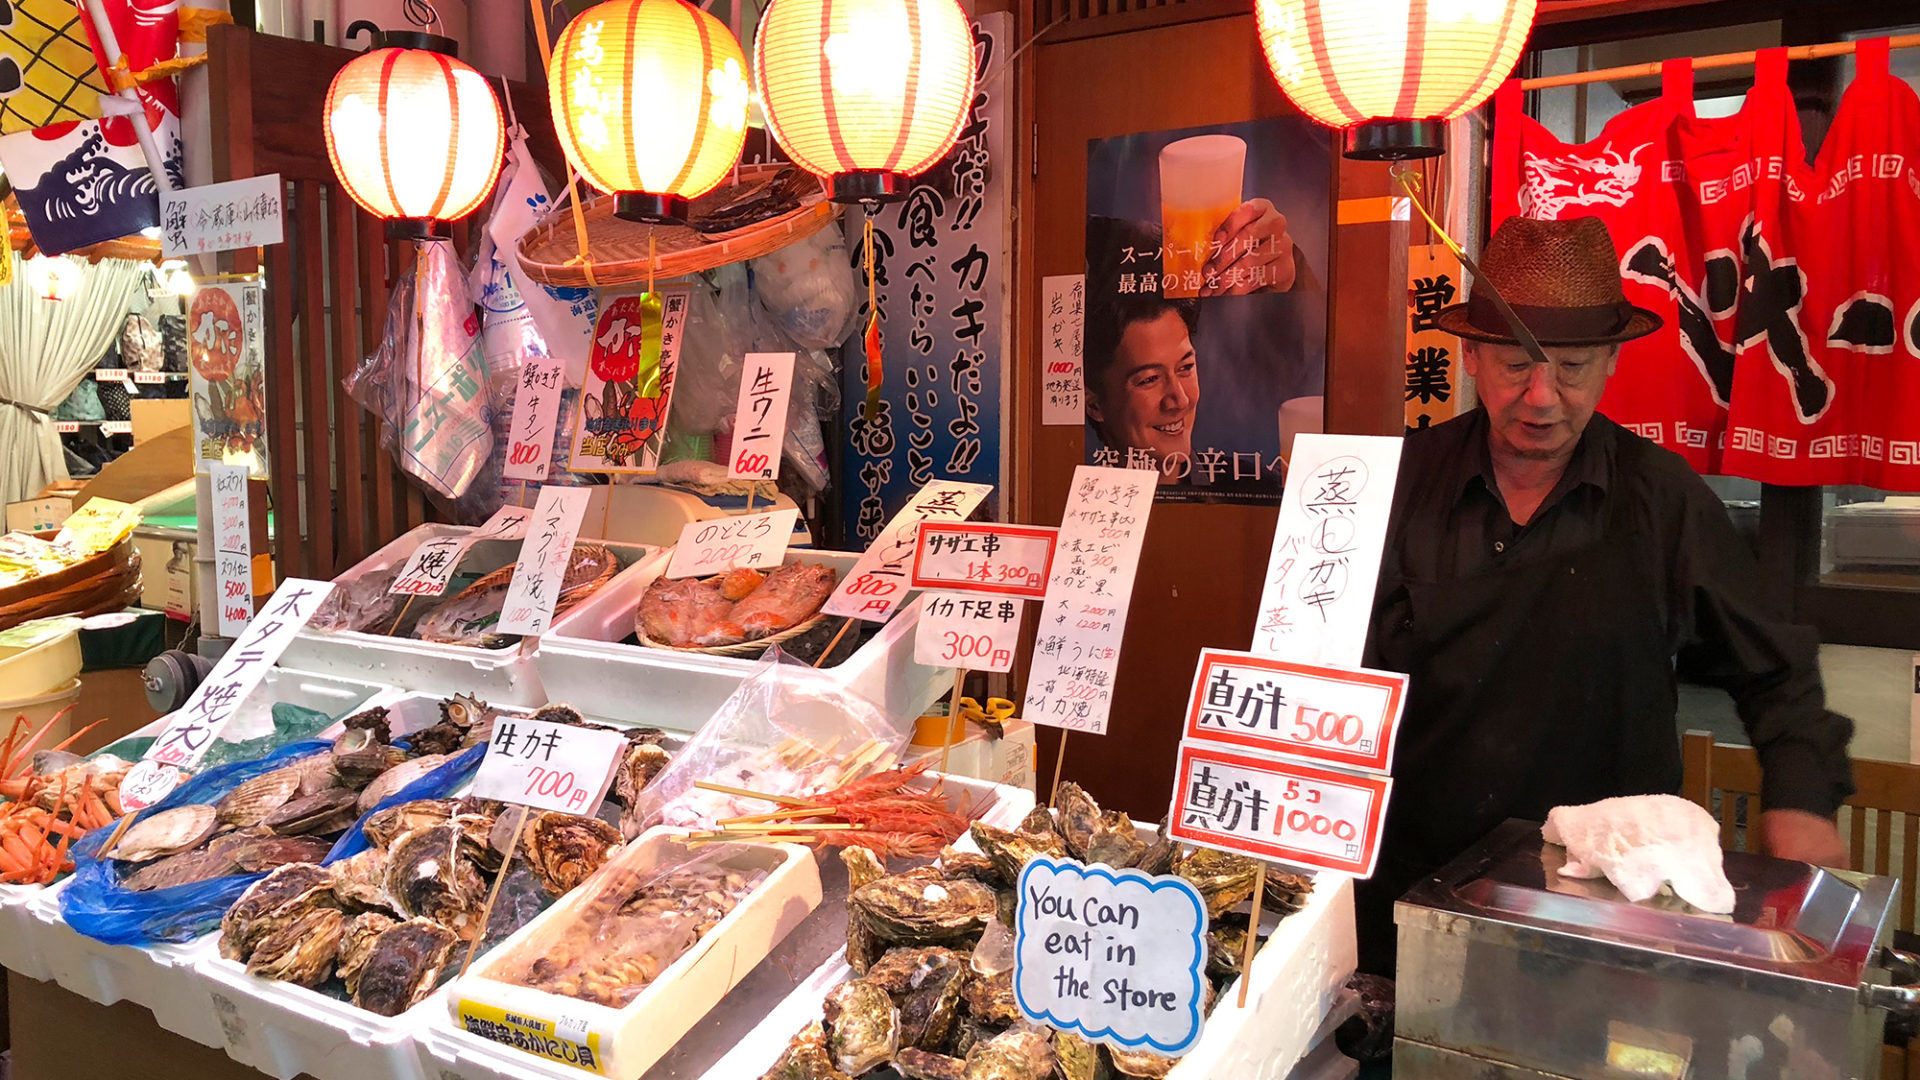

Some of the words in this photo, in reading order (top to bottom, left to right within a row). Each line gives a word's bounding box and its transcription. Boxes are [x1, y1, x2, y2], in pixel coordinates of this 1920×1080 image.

[1119, 233, 1283, 265] スーパードライ史上
[1117, 264, 1278, 294] 最高の泡を実現!
[524, 394, 545, 442] 牛タン
[743, 366, 780, 442] 生ウニ
[695, 516, 772, 544] のどくろ
[927, 533, 1001, 558] サザエ串
[1303, 466, 1358, 623] 蒸しガキ
[998, 566, 1042, 587] 300円
[1260, 535, 1306, 651] バター蒸し
[925, 597, 1015, 623] イカ下足串
[1055, 614, 1067, 626] 中
[1058, 599, 1069, 609] 大
[941, 631, 1011, 667] 300円
[1200, 669, 1288, 730] 真ガキ
[1290, 705, 1374, 753] 500円
[494, 723, 563, 761] 生カキ
[524, 766, 588, 811] 700円
[1184, 766, 1270, 831] 真ガキ
[1029, 885, 1078, 921] You
[1044, 931, 1092, 961] eat
[1106, 935, 1136, 966] in
[1053, 965, 1089, 999] the
